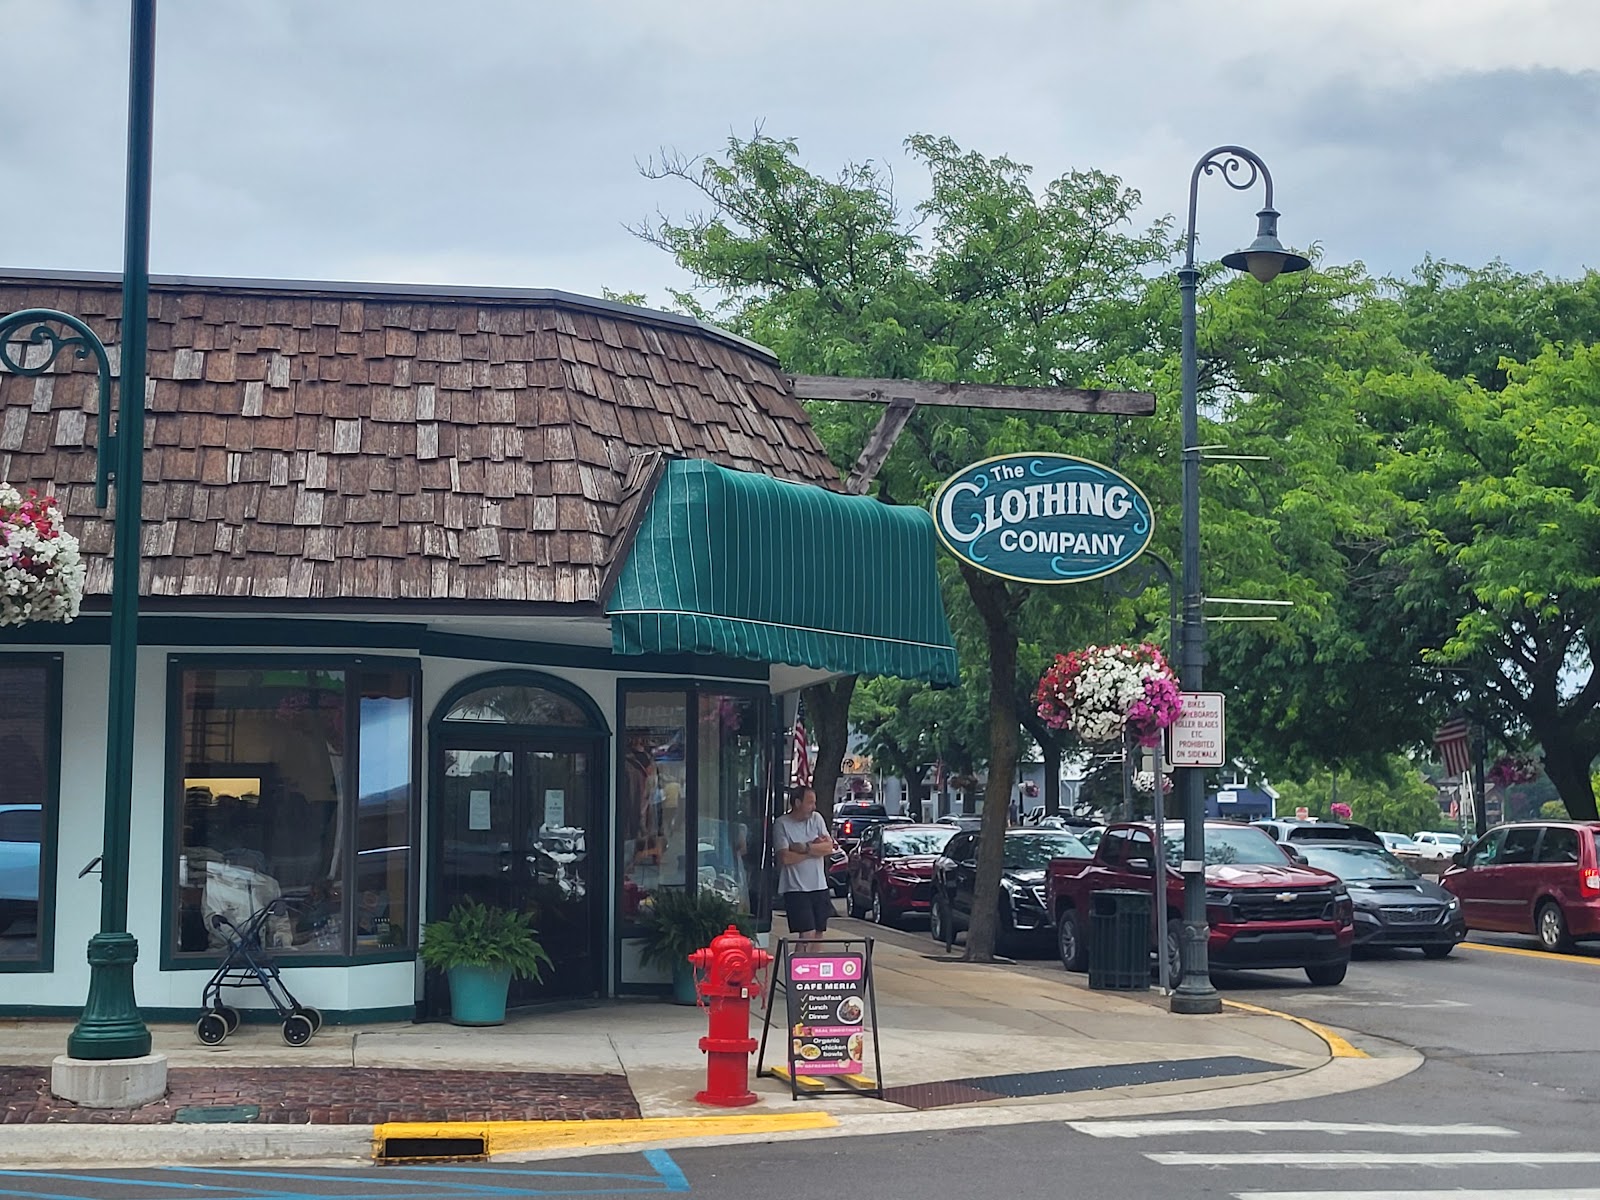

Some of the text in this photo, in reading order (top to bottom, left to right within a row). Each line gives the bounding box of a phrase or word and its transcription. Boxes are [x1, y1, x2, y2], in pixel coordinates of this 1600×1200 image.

[989, 464, 1025, 482] The
[941, 481, 1133, 543] CLOTHING
[1000, 530, 1125, 556] COMPANY
[1197, 720, 1219, 728] BLADES
[1176, 750, 1218, 758] ON SIDEWALK
[813, 1037, 840, 1045] Organic
